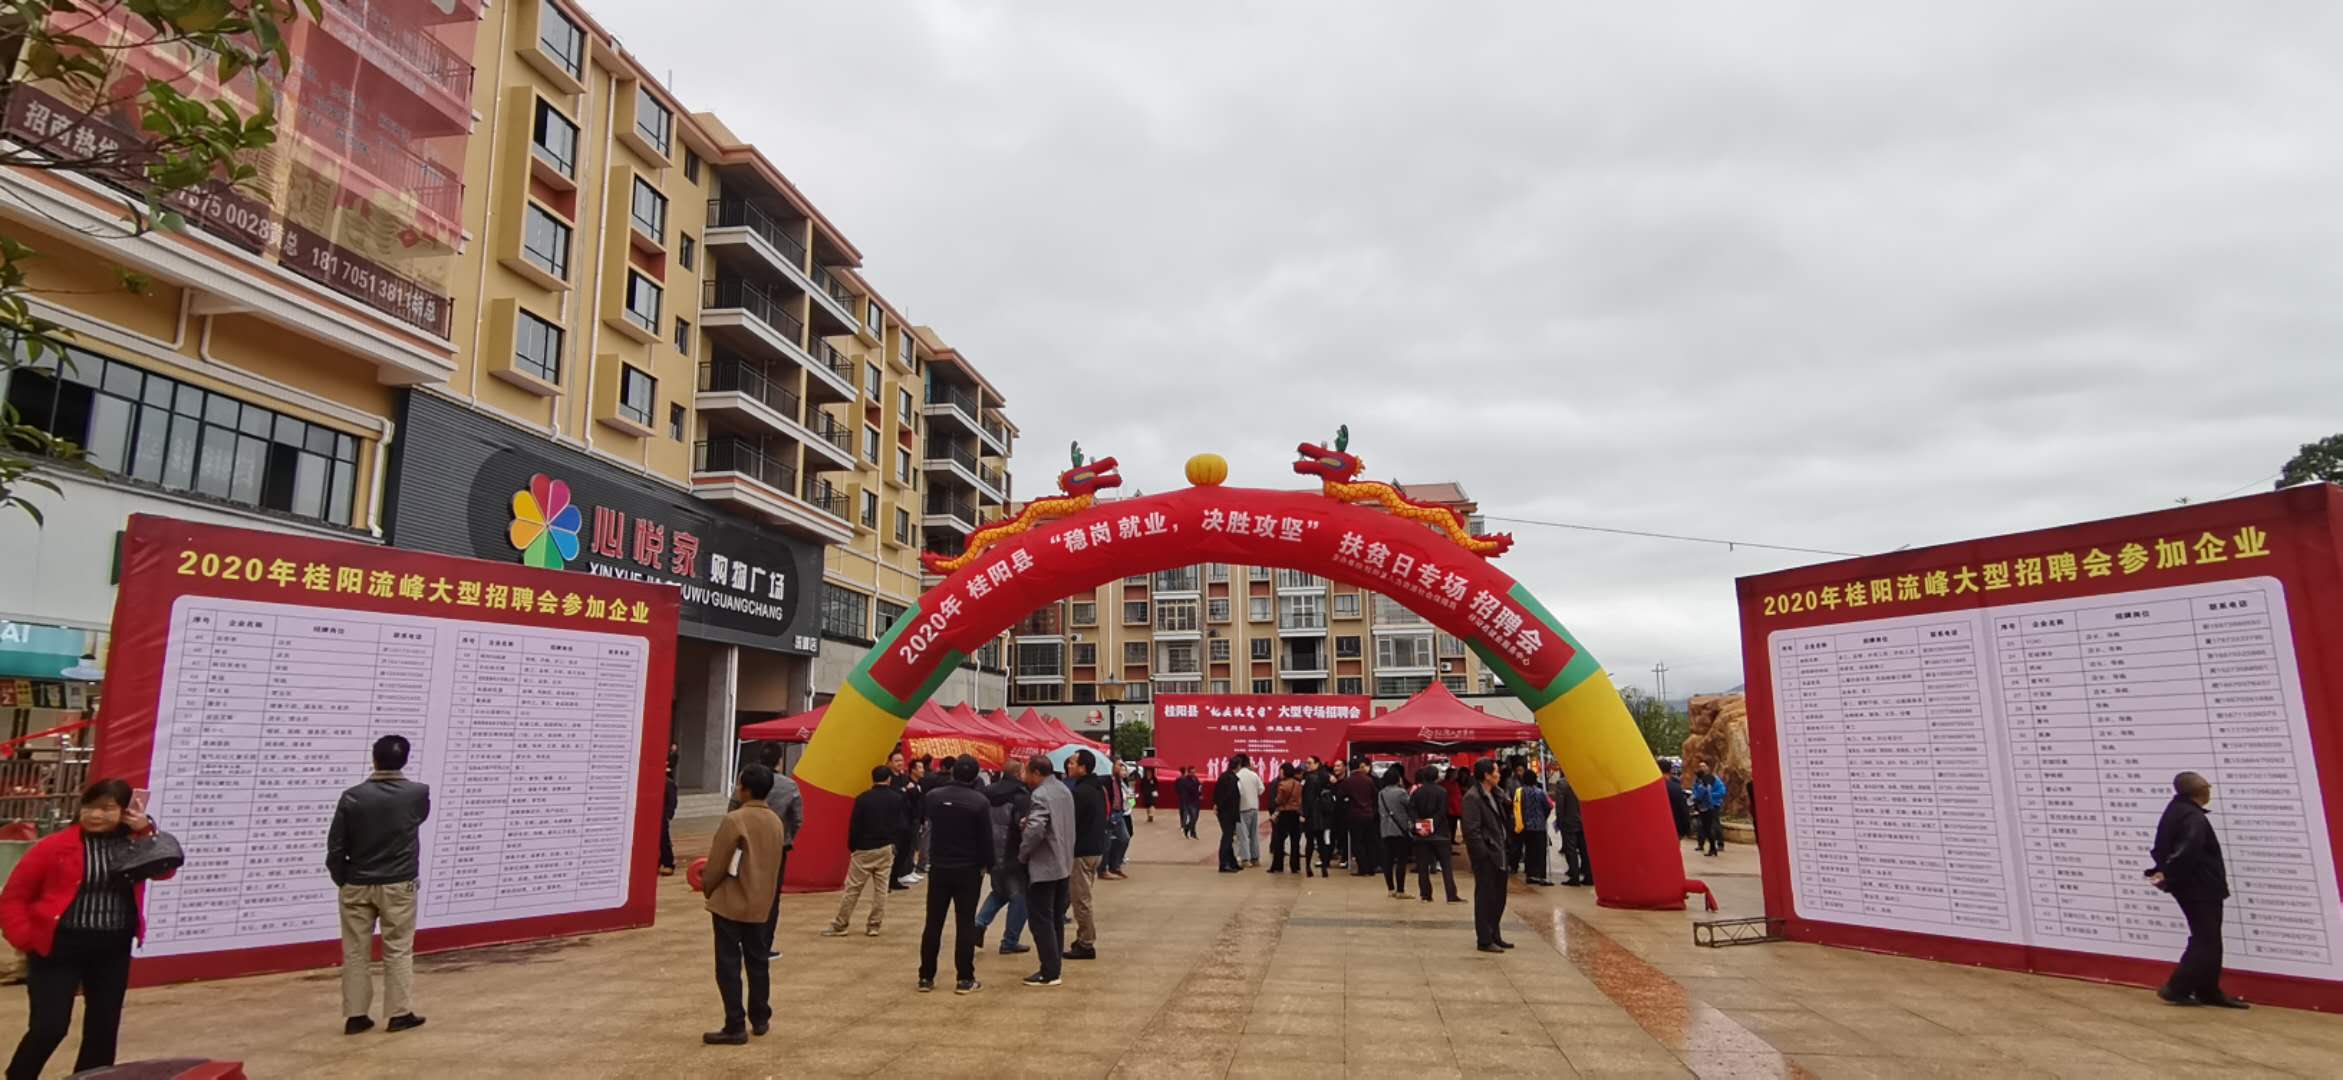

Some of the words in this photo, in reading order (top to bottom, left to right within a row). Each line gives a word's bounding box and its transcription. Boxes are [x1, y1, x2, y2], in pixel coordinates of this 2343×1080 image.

[591, 505, 700, 578] 心悦家
[710, 552, 785, 601] 购物广场
[1763, 526, 2271, 616] 2020年桂阳流峰大型招聘会参加企业
[177, 550, 650, 624] 2020年桂阳流峰大型招聘会参加企业
[711, 591, 783, 621] GUANGCHANG
